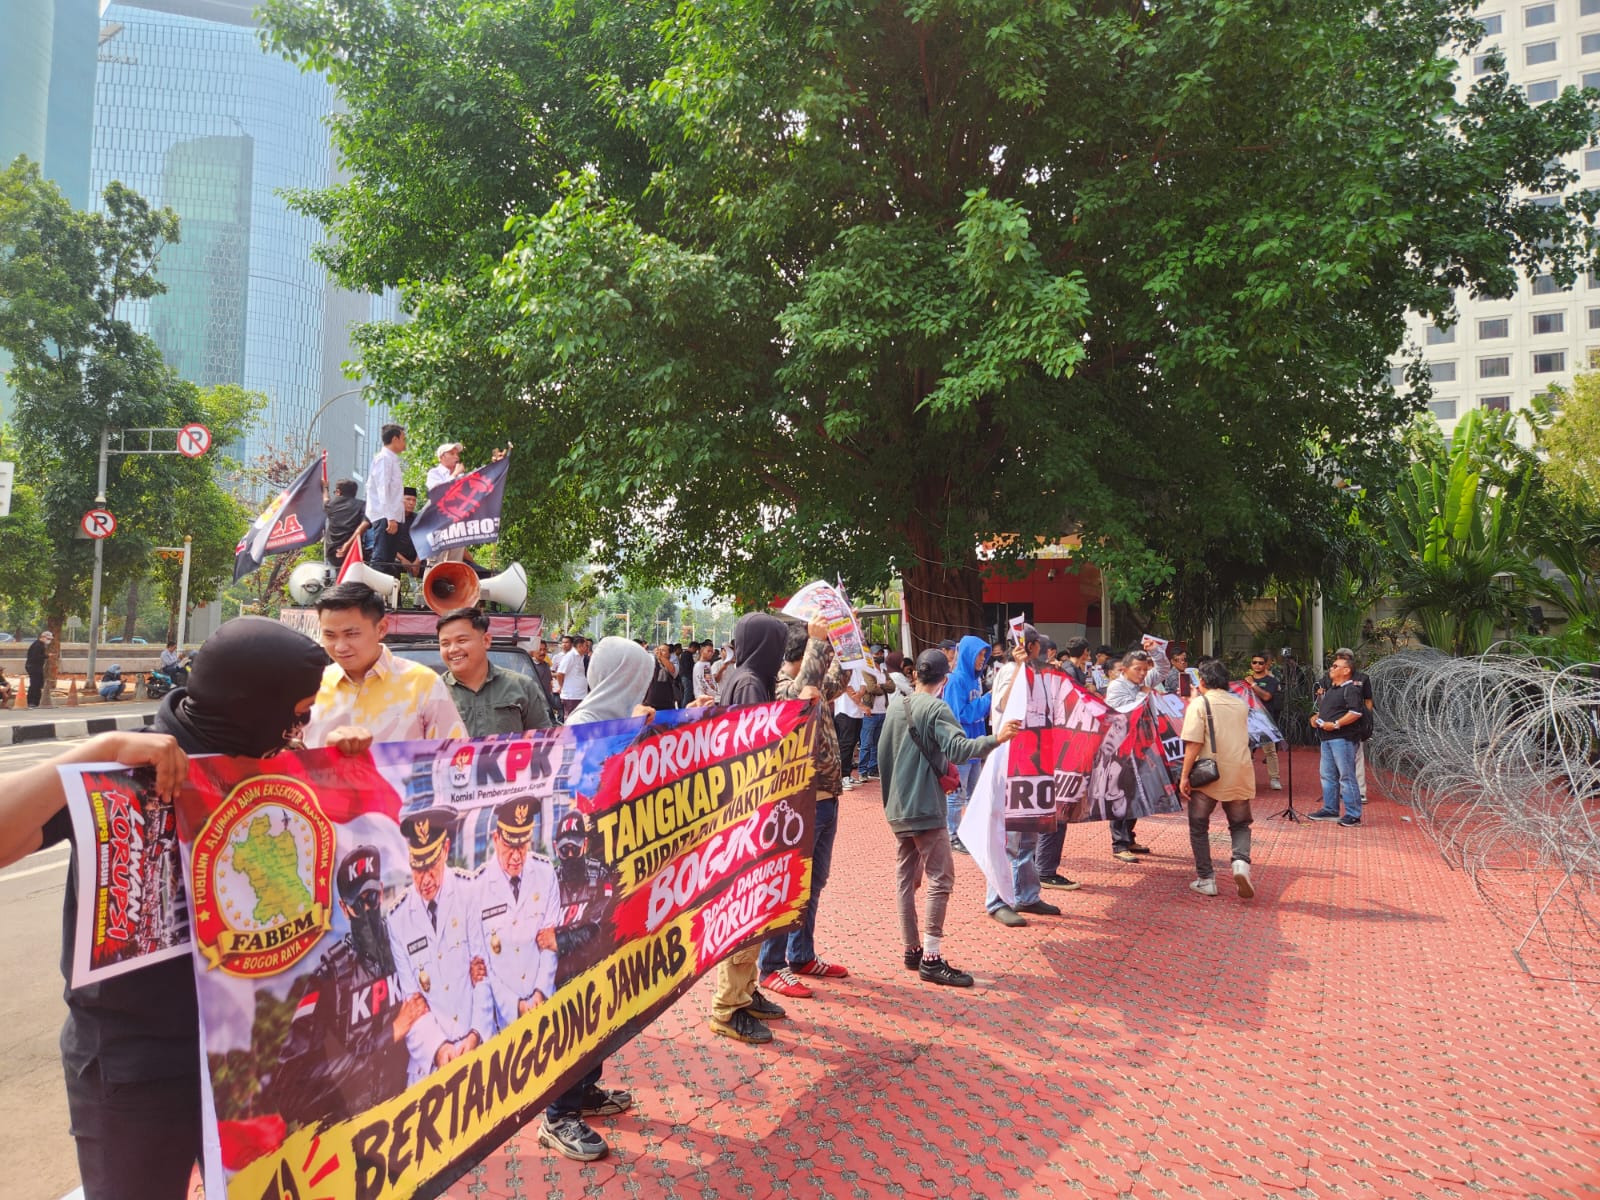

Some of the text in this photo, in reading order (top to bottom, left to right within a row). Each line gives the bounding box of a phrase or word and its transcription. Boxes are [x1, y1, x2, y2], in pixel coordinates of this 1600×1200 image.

[476, 741, 556, 786] KPK
[620, 700, 786, 800] DORONG KPK
[450, 790, 475, 804] Komisi
[454, 773, 466, 781] KPK
[597, 766, 726, 867] TANGKAP
[91, 791, 109, 945] KORUPSI MUSUH BERSAMA
[102, 790, 130, 940] KORUPSI
[127, 805, 145, 923] LAWAN
[348, 856, 374, 882] KPK
[736, 853, 792, 898] DARURAT
[230, 911, 315, 951] FABEM
[702, 872, 790, 963] KORUPSI
[243, 940, 302, 970] BOGOR RAYA
[351, 972, 402, 1025] KPK
[351, 925, 688, 1200] BERTANGGUNG JAWAB
